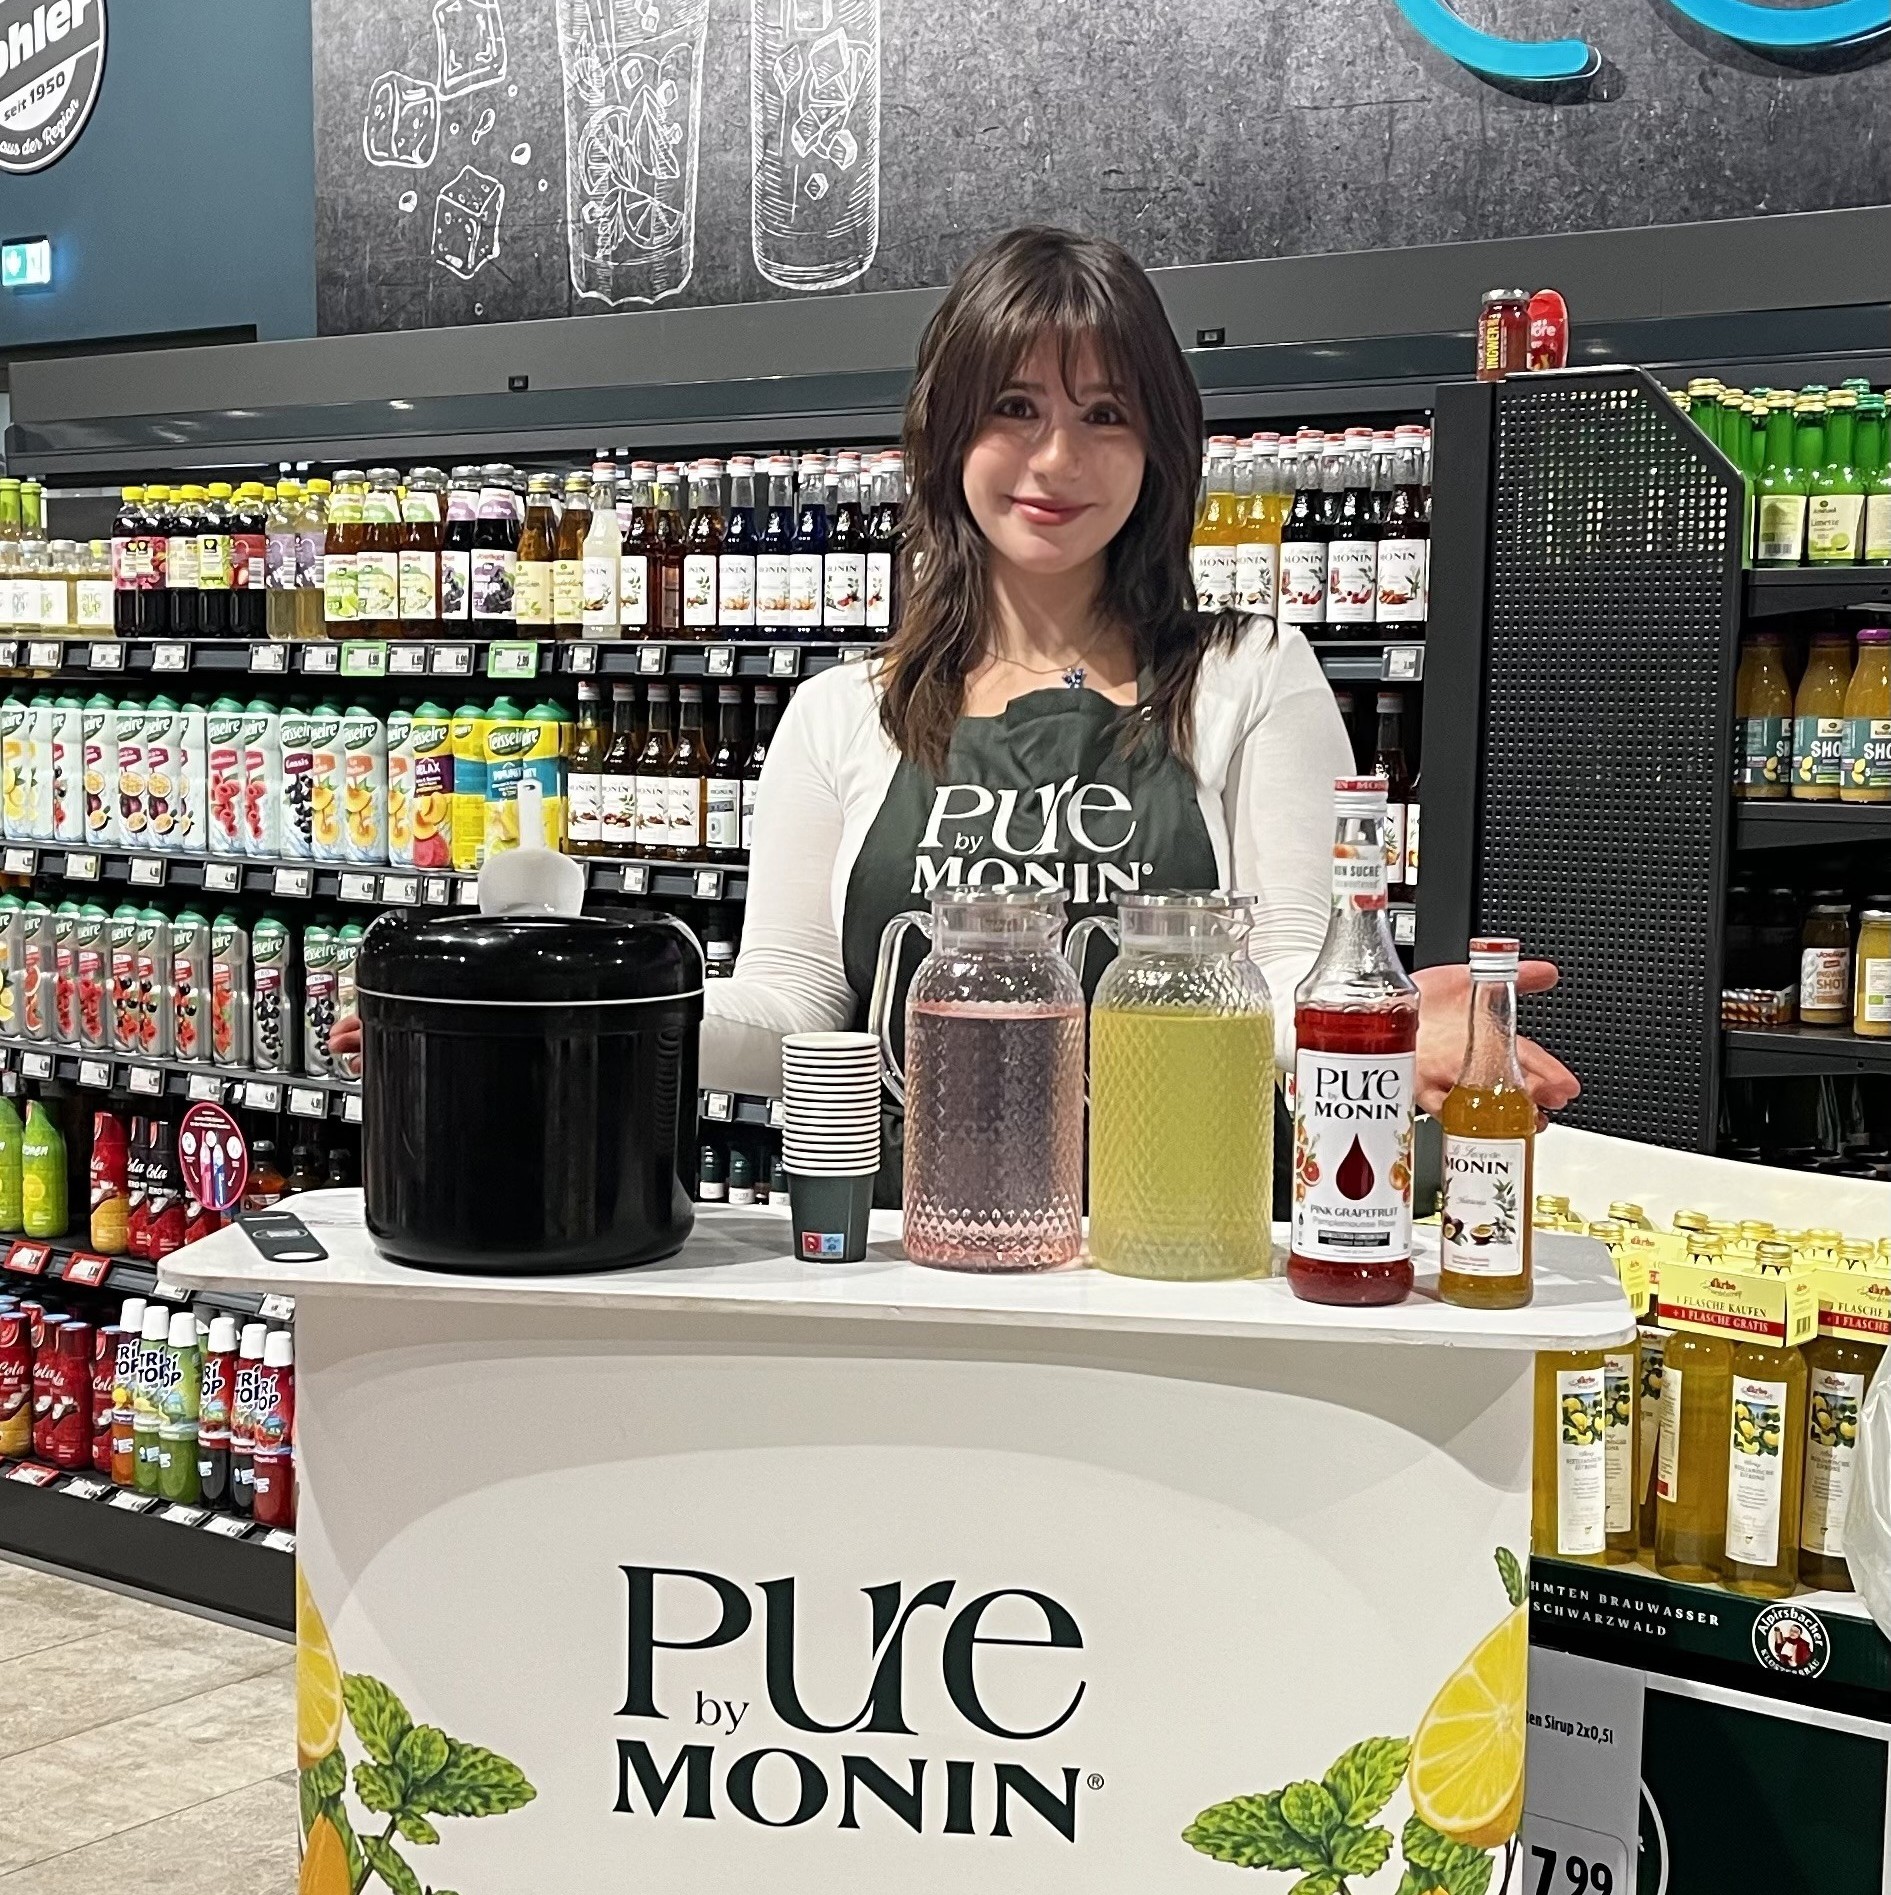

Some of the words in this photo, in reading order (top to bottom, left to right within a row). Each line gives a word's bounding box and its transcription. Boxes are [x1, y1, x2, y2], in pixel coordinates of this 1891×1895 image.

[4, 99, 27, 121] seit
[29, 70, 65, 104] 1950
[21, 137, 42, 155] der
[41, 98, 79, 146] Region
[953, 832, 984, 854] by
[1314, 1100, 1400, 1120] MONIN
[1310, 1204, 1332, 1216] PINK
[1334, 1206, 1399, 1218] GRAPEFRUIT
[1683, 1296, 1725, 1312] FLASCHE
[1728, 1302, 1767, 1318] KAUFEN
[1688, 1310, 1731, 1328] FLASCHE
[1732, 1317, 1769, 1334] GRATIS
[1838, 1301, 1883, 1318] FLASCHE
[1842, 1316, 1889, 1333] FLASCHE
[1530, 1579, 1590, 1601] HMTEN
[1598, 1592, 1721, 1627] BRAUWASSER
[1532, 1600, 1668, 1637] SCHWARZWALD
[1757, 1607, 1824, 1647] Alpirsbacher
[613, 1564, 1087, 1741] Pure
[694, 1690, 750, 1736] by
[1544, 1714, 1574, 1737] Sirup
[1576, 1721, 1614, 1744] 2x0,5l
